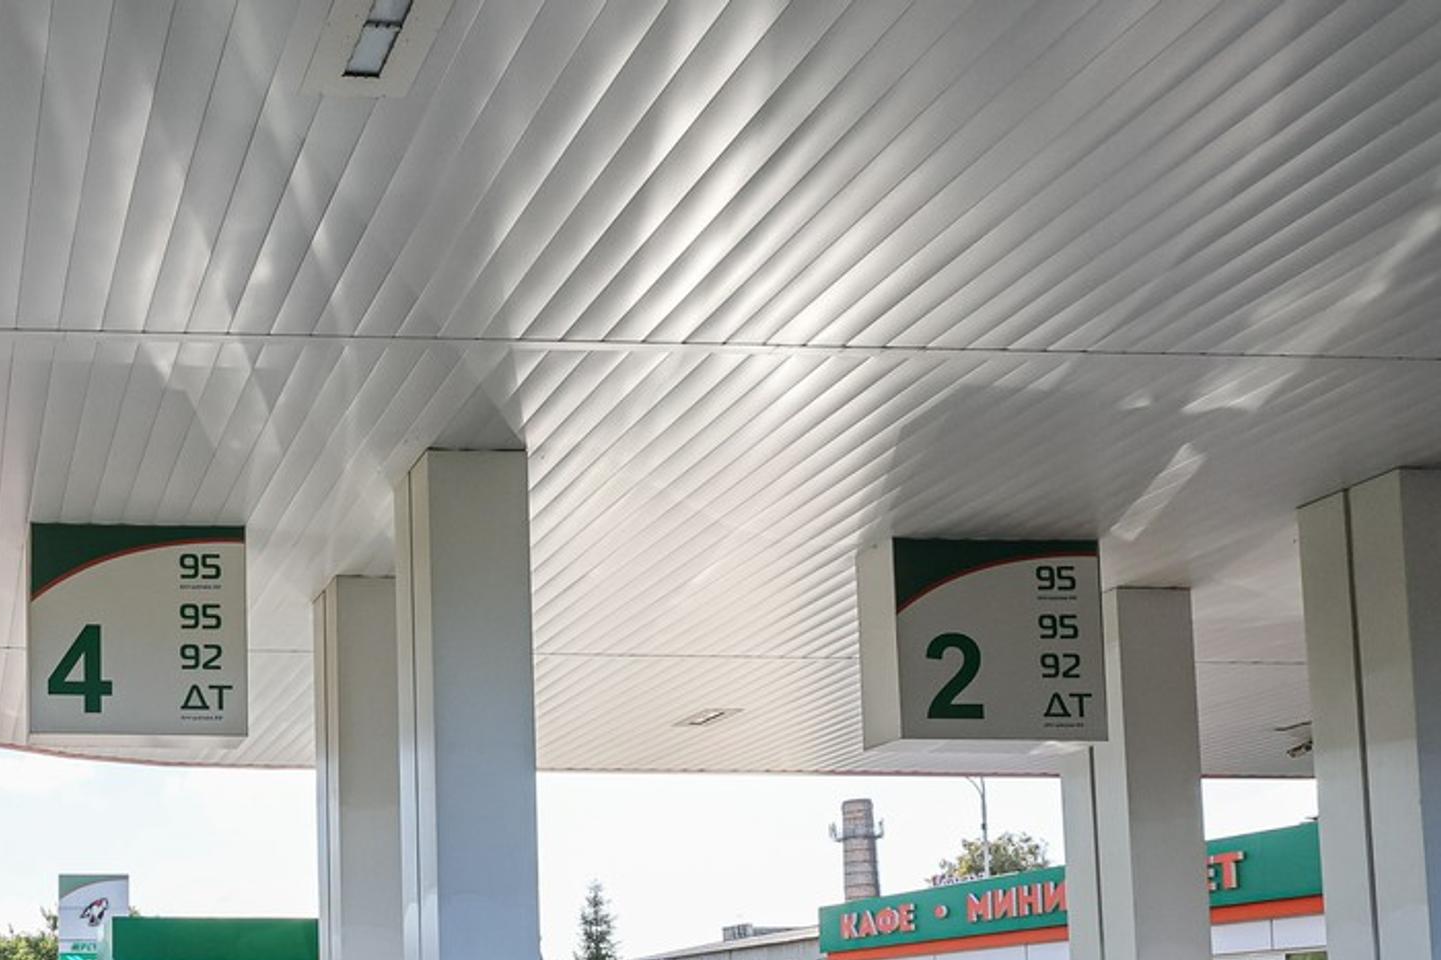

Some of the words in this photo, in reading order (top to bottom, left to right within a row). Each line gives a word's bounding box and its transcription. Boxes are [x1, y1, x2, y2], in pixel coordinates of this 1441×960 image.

[179, 553, 221, 579] 95
[1035, 565, 1076, 591] 95
[179, 604, 222, 629] 95
[1038, 614, 1078, 639] 95
[47, 623, 113, 713] 4
[179, 644, 222, 670] 92
[1040, 653, 1080, 678] 92
[925, 632, 985, 719] 2
[839, 903, 916, 940] КАФЕ
